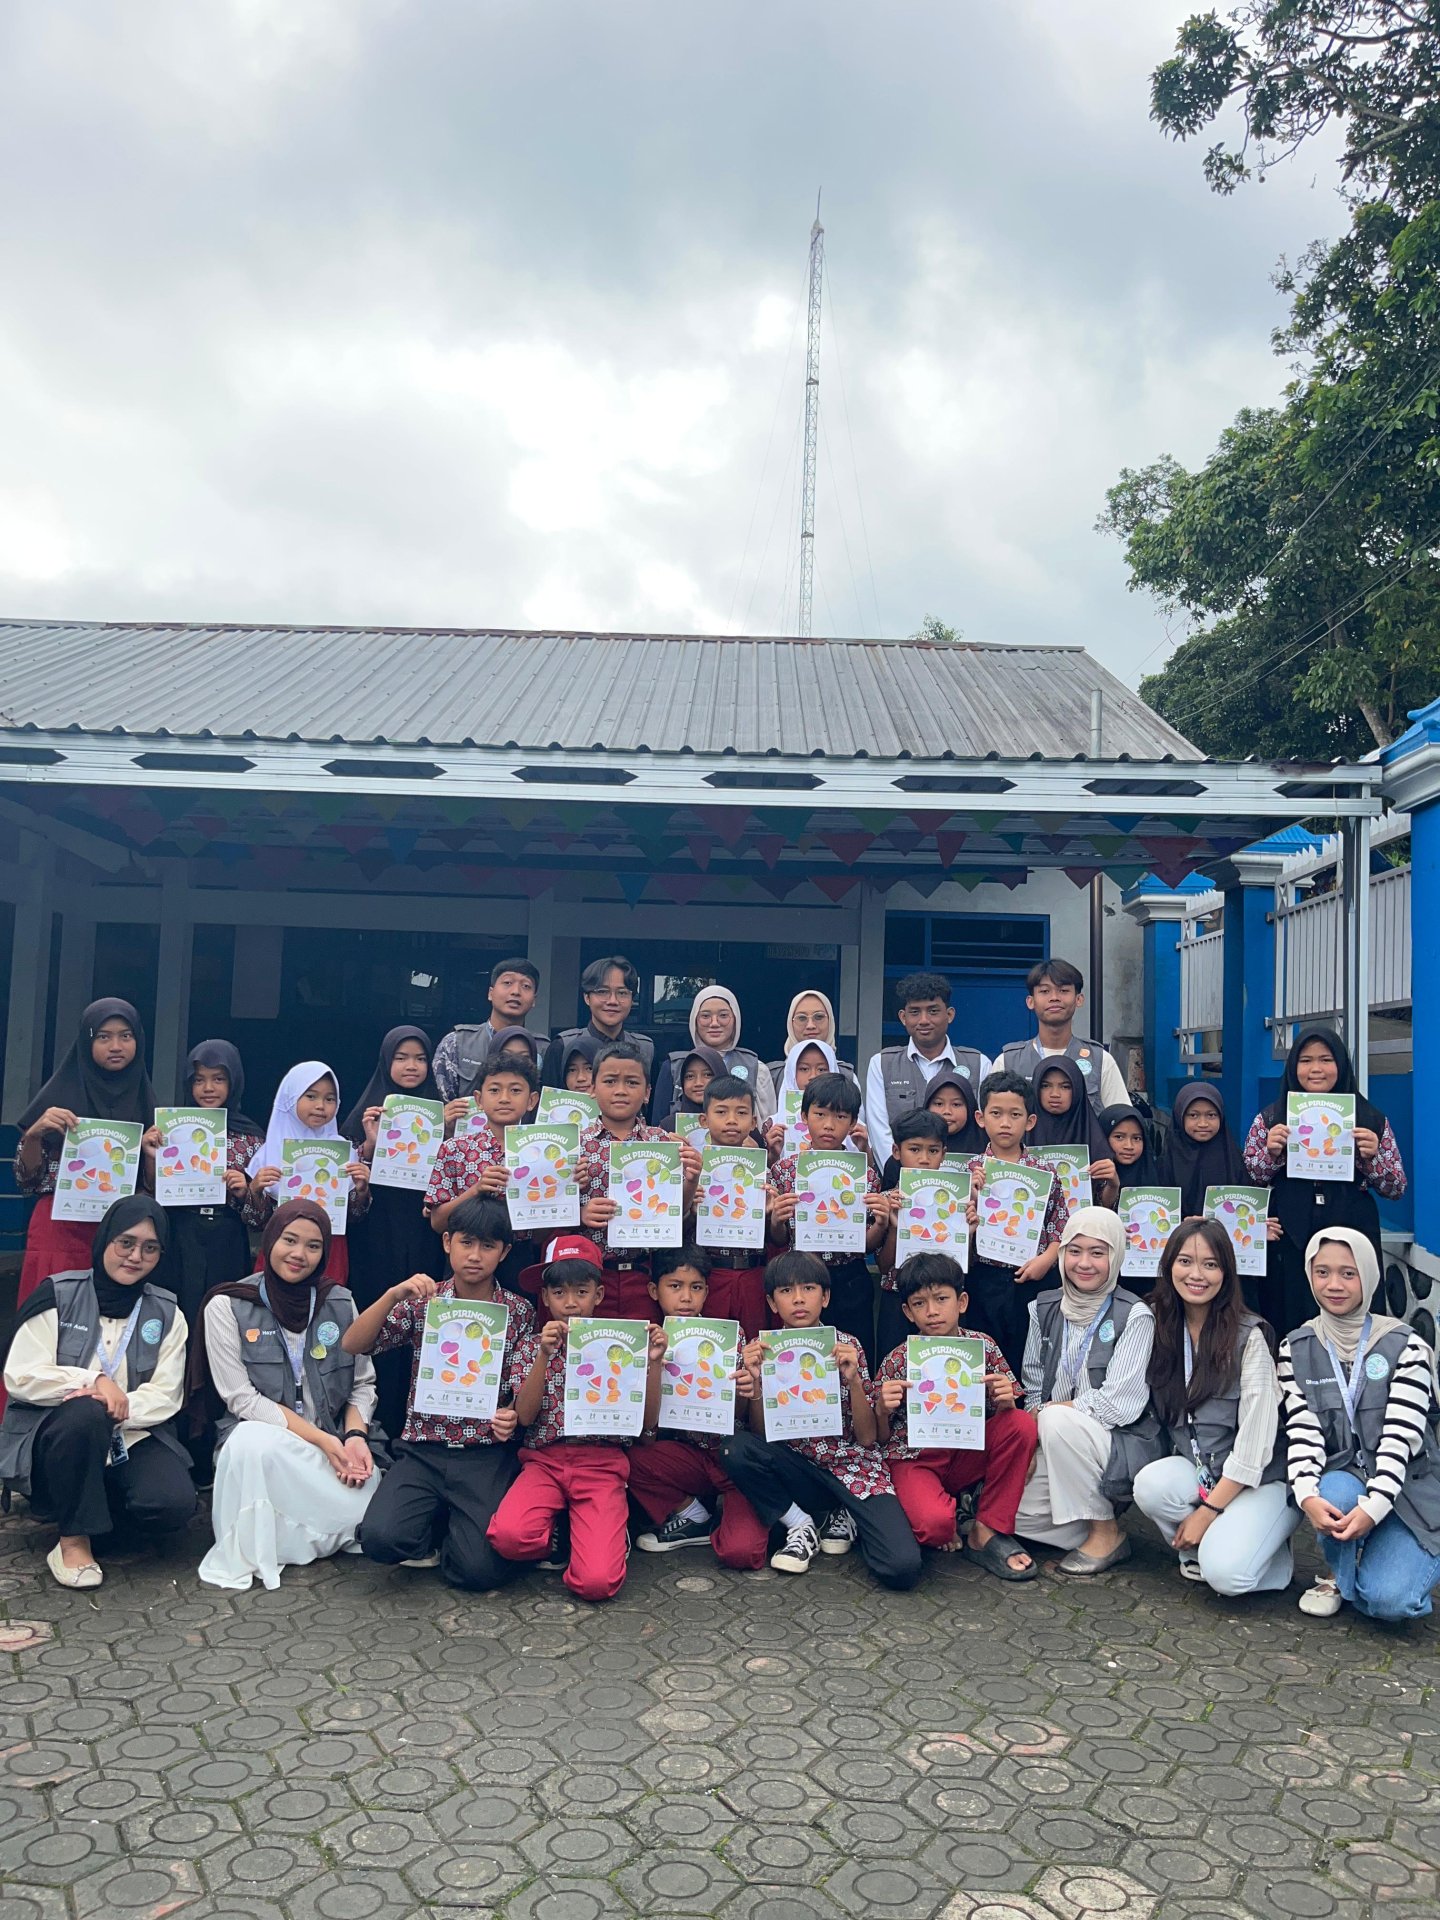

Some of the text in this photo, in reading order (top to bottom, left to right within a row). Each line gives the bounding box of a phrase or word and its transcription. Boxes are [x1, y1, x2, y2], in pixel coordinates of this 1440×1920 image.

[392, 1104, 437, 1120] ISI PIRINGKU
[549, 1098, 592, 1113] ISI PIRINGKU
[1297, 1101, 1345, 1112] ISI PIRINGKU
[166, 1115, 216, 1129] ISI PIRINGKU
[683, 1123, 694, 1132] ISI
[78, 1128, 130, 1144] ISI PIRINGKU
[517, 1132, 569, 1147] ISI PIRINGKU
[292, 1146, 340, 1159] ISI PIRINGKU
[621, 1150, 672, 1164] ISI PIRINGKU
[1044, 1152, 1079, 1164] PIRINGKU
[710, 1156, 756, 1169] ISI PIRINGKU
[807, 1159, 856, 1173] ISI PIRINGKU
[910, 1178, 960, 1192] ISI PIRINGKU
[991, 1171, 1040, 1190] ISI PIRINGKU
[1126, 1194, 1171, 1207] ISI PIRINGKU
[1212, 1193, 1258, 1206] ISI PIRINGKU
[438, 1309, 496, 1327] ISI PIRINGKU
[580, 1329, 637, 1344] ISI PIRINGKU
[674, 1328, 726, 1344] ISI PIRINGKU
[784, 1337, 825, 1351] PIRINGKU
[918, 1346, 973, 1361] ISI PIRINGKU
